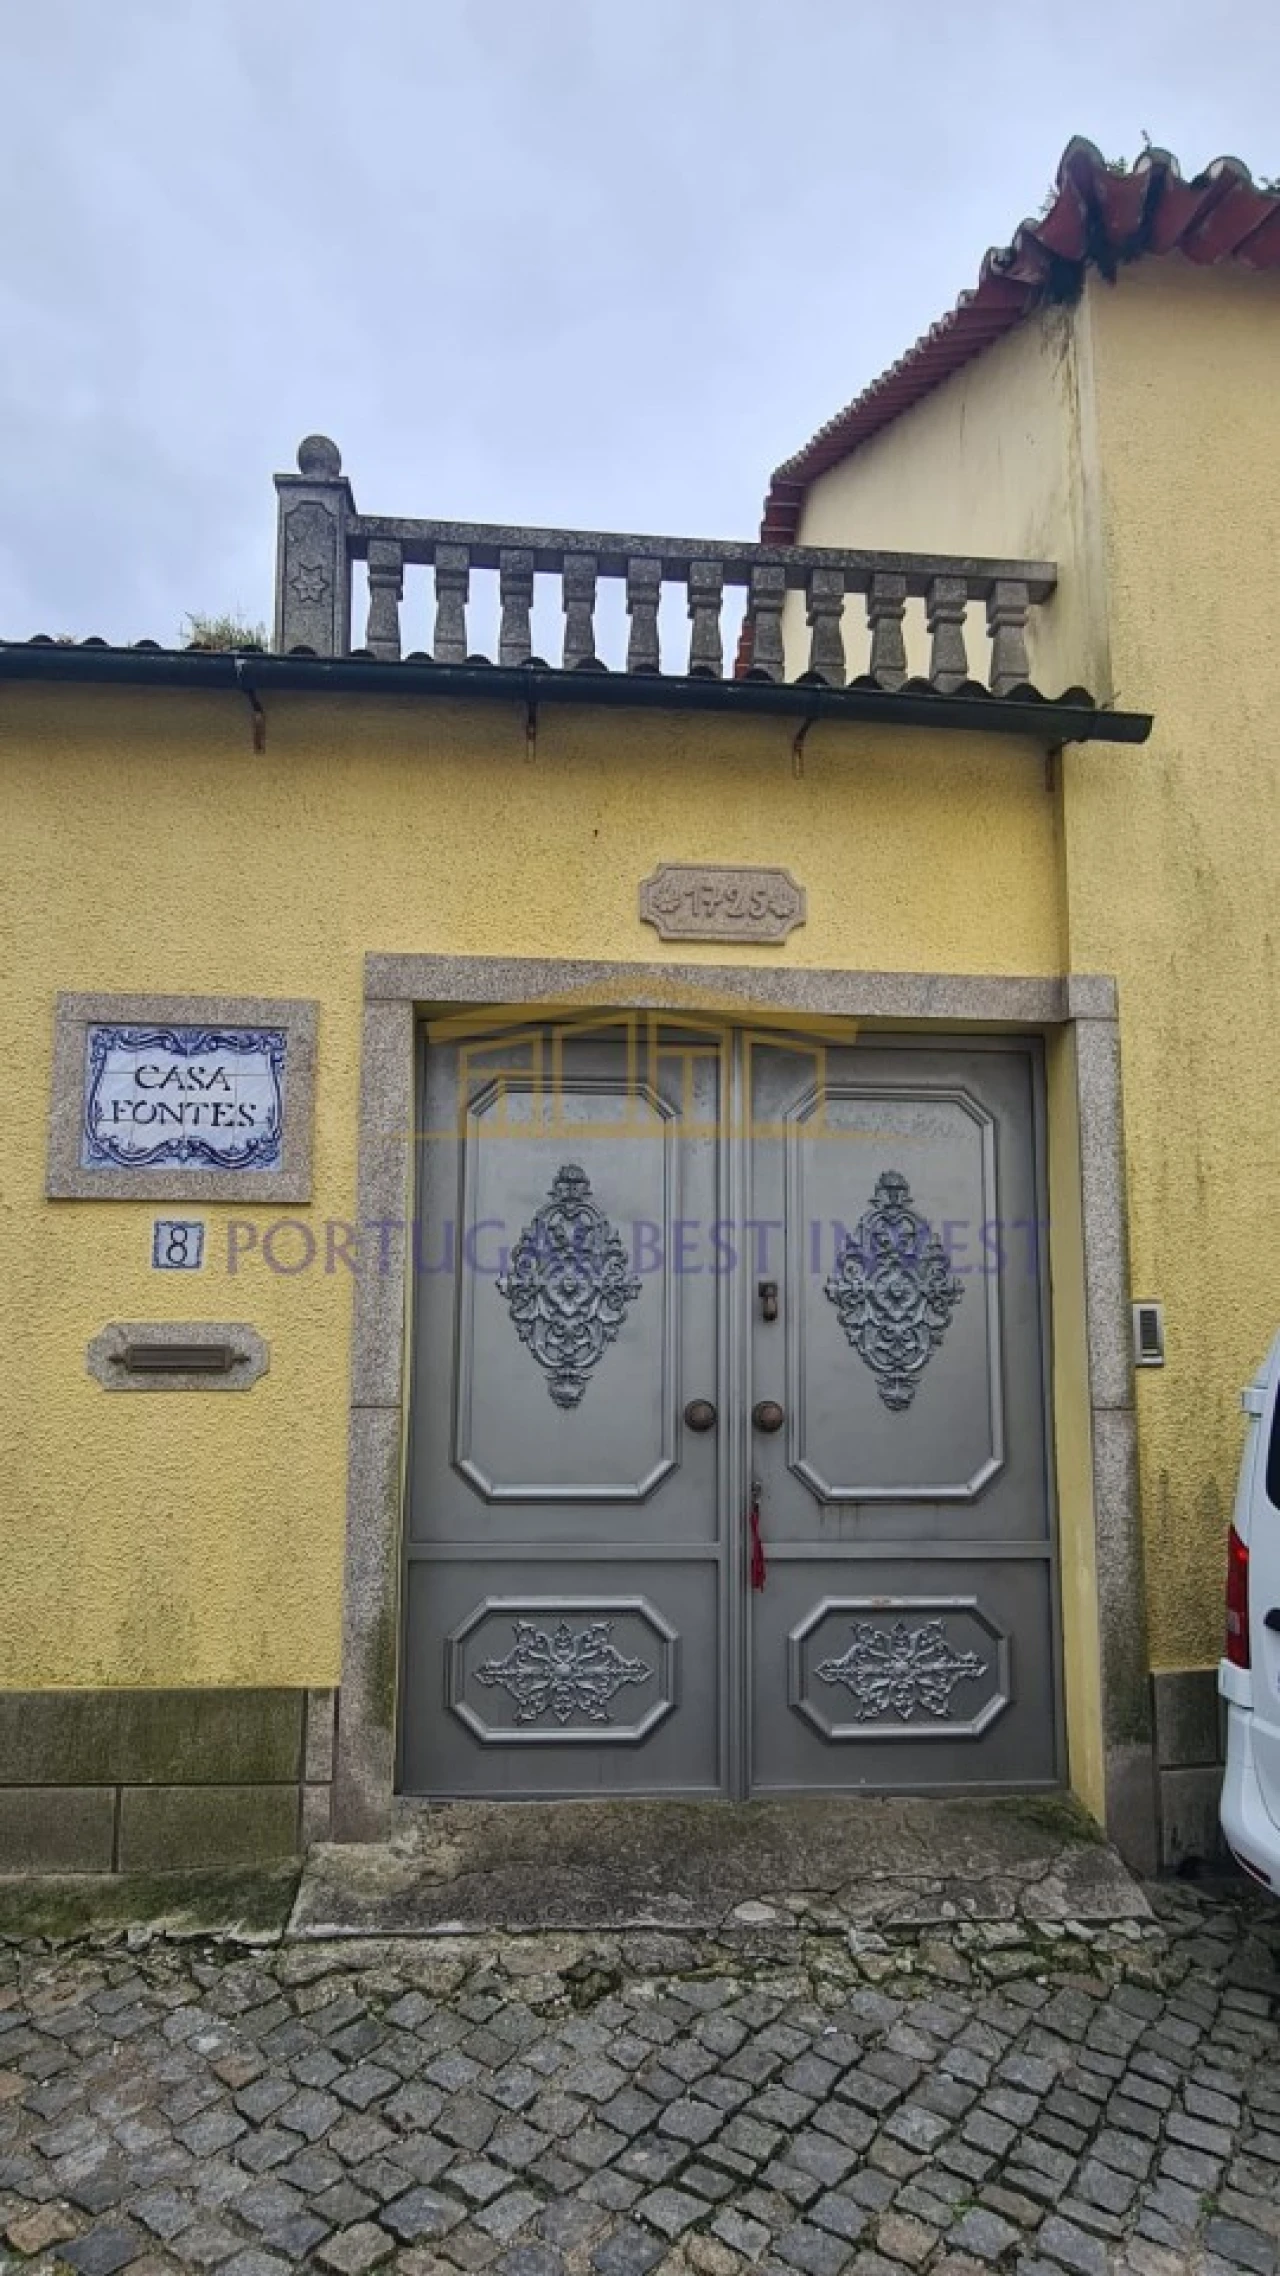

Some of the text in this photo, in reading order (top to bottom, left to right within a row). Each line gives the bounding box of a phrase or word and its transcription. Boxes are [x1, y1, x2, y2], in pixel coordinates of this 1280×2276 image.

[683, 885, 767, 920] 1725
[133, 1065, 231, 1092] CASA
[111, 1099, 257, 1127] FONTES
[166, 1225, 189, 1266] 8
